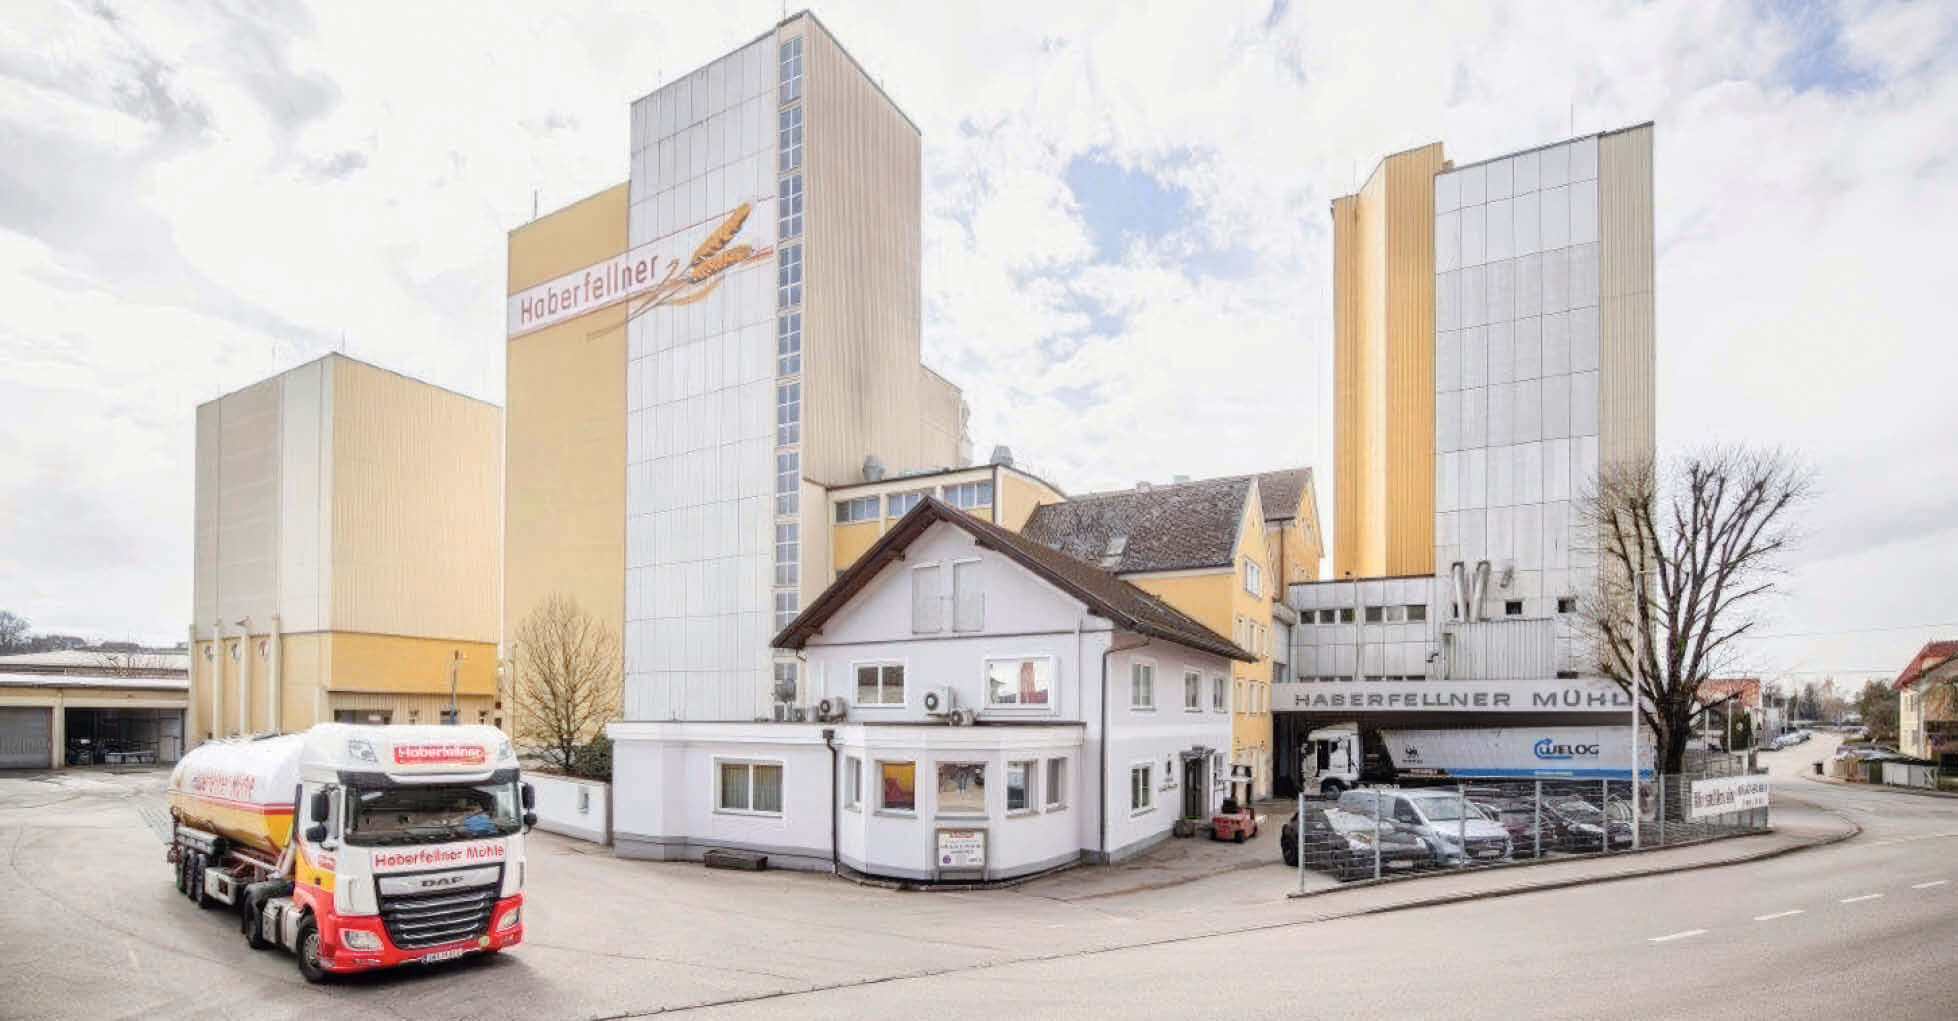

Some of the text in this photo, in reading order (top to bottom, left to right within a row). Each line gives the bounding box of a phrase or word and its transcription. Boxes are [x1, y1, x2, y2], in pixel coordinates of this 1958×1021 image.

[520, 255, 659, 325] Haberfellner
[1295, 689, 1636, 707] HABERFELLNER MÜHL
[375, 849, 463, 867] Haberfellner
[421, 875, 464, 887] DAF
